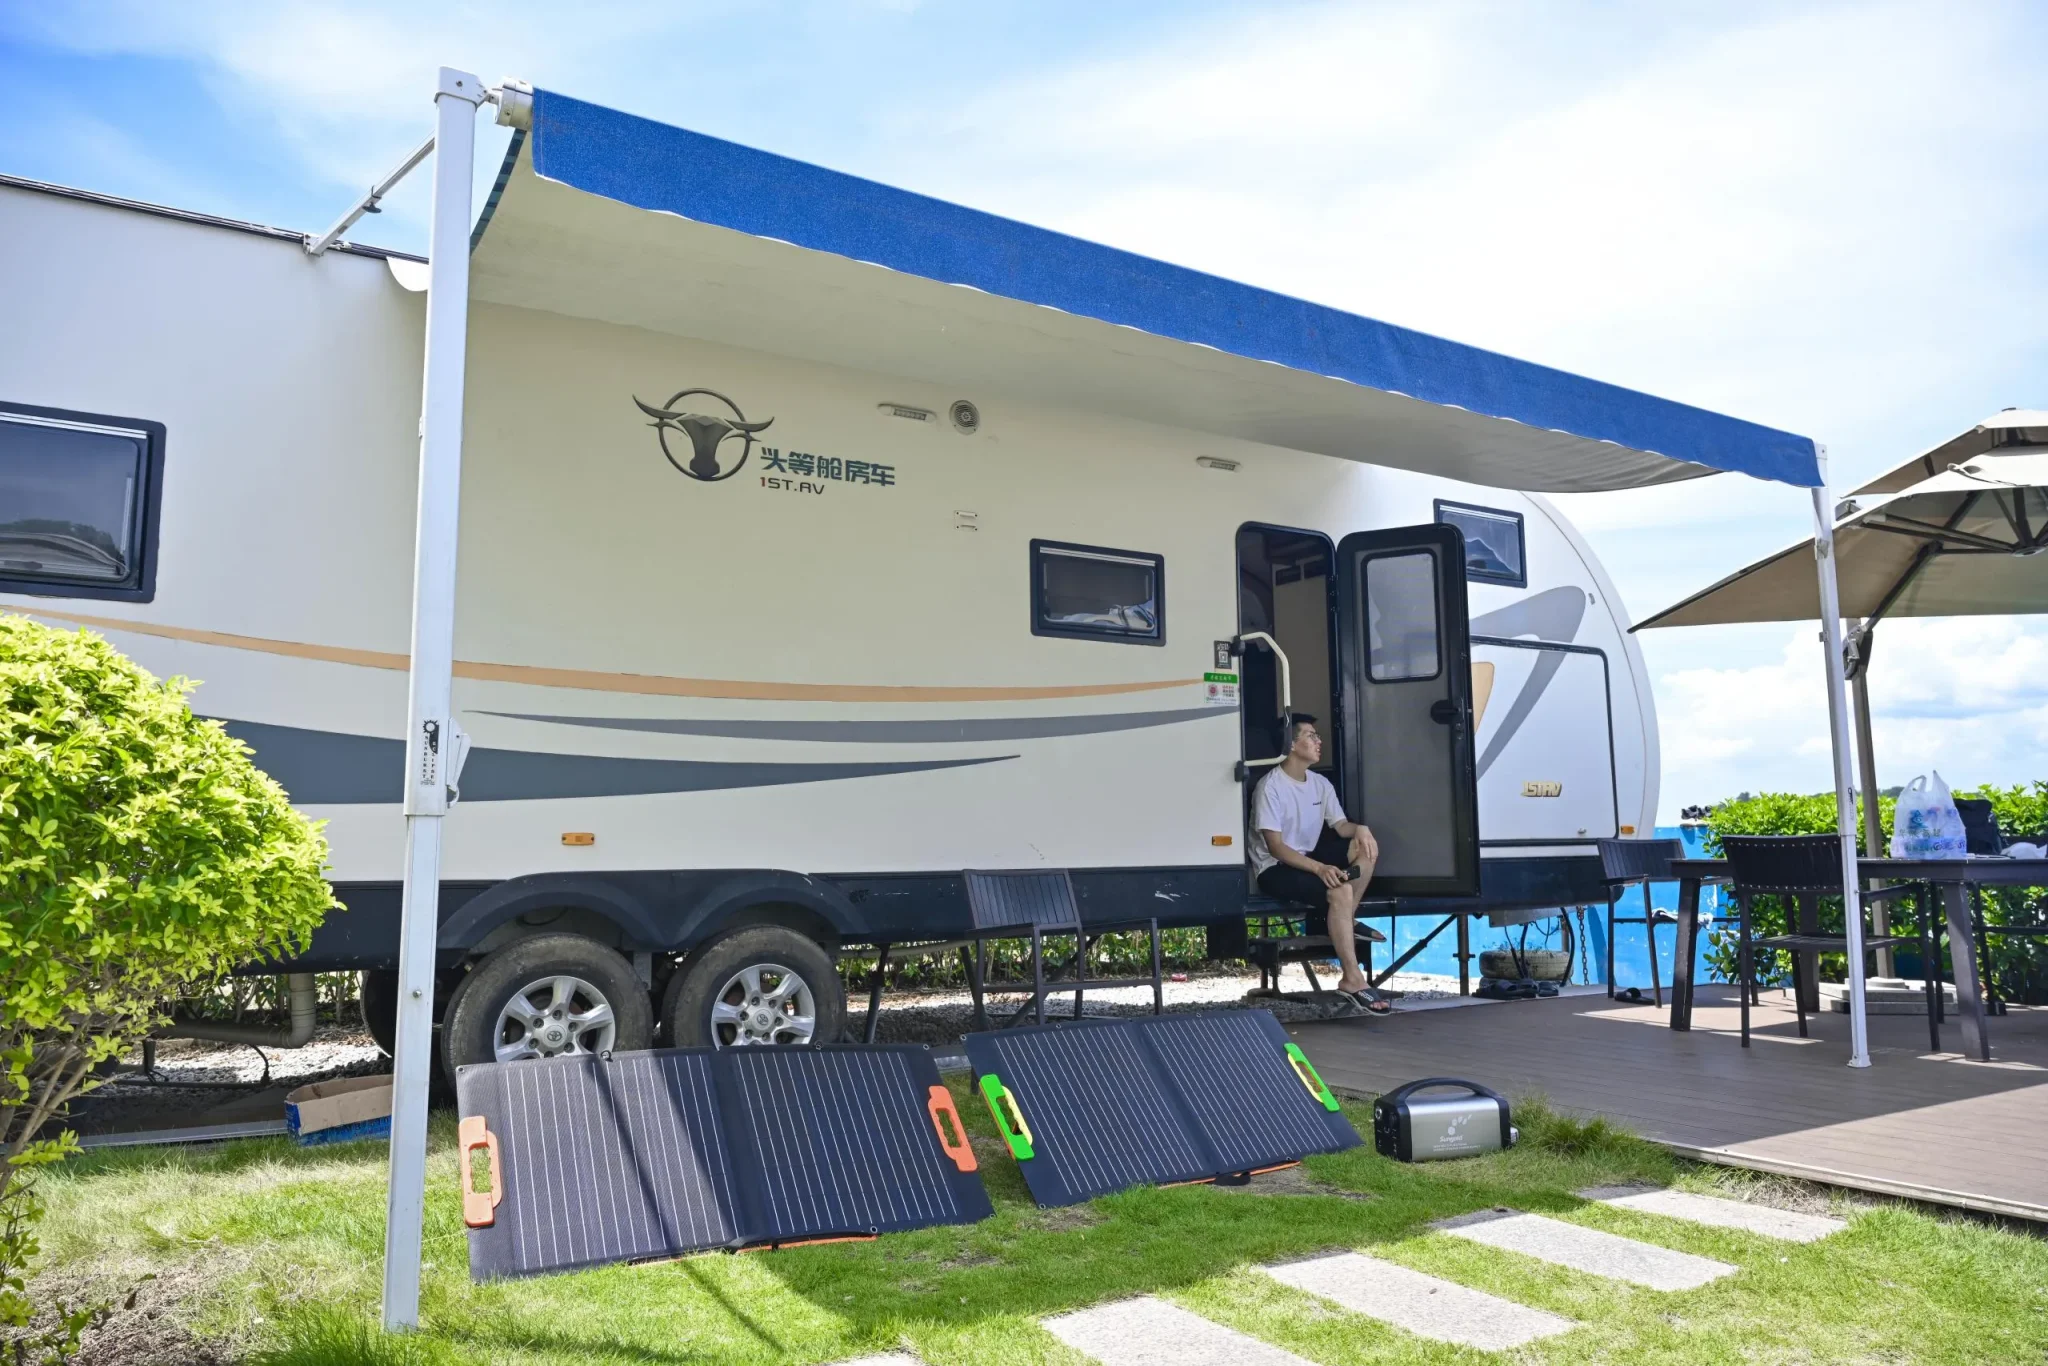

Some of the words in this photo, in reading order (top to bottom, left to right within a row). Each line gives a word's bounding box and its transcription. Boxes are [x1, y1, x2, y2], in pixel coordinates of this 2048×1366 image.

[760, 446, 895, 486] 头等舱房车
[760, 476, 825, 495] 1ST.RV
